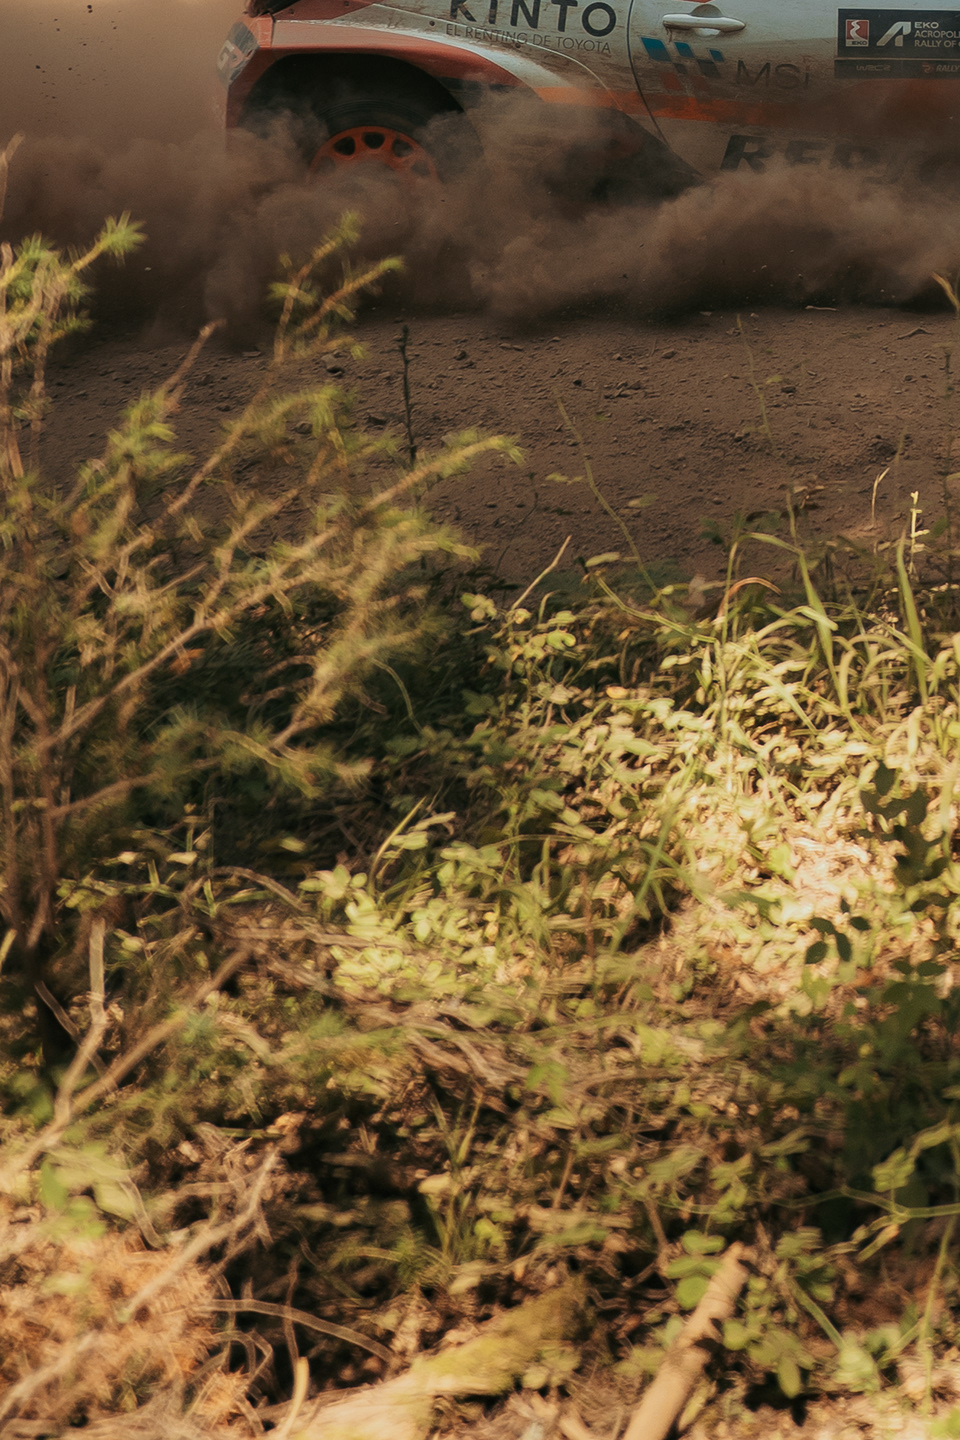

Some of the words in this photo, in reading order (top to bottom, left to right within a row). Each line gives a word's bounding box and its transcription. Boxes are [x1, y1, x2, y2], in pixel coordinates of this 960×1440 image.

[914, 21, 939, 29] EKO
[446, 23, 461, 37] EL
[465, 26, 528, 45] RENTING
[533, 34, 552, 47] DE
[556, 36, 611, 54] TOYOTA
[914, 39, 942, 48] RALLY
[944, 39, 958, 48] OF
